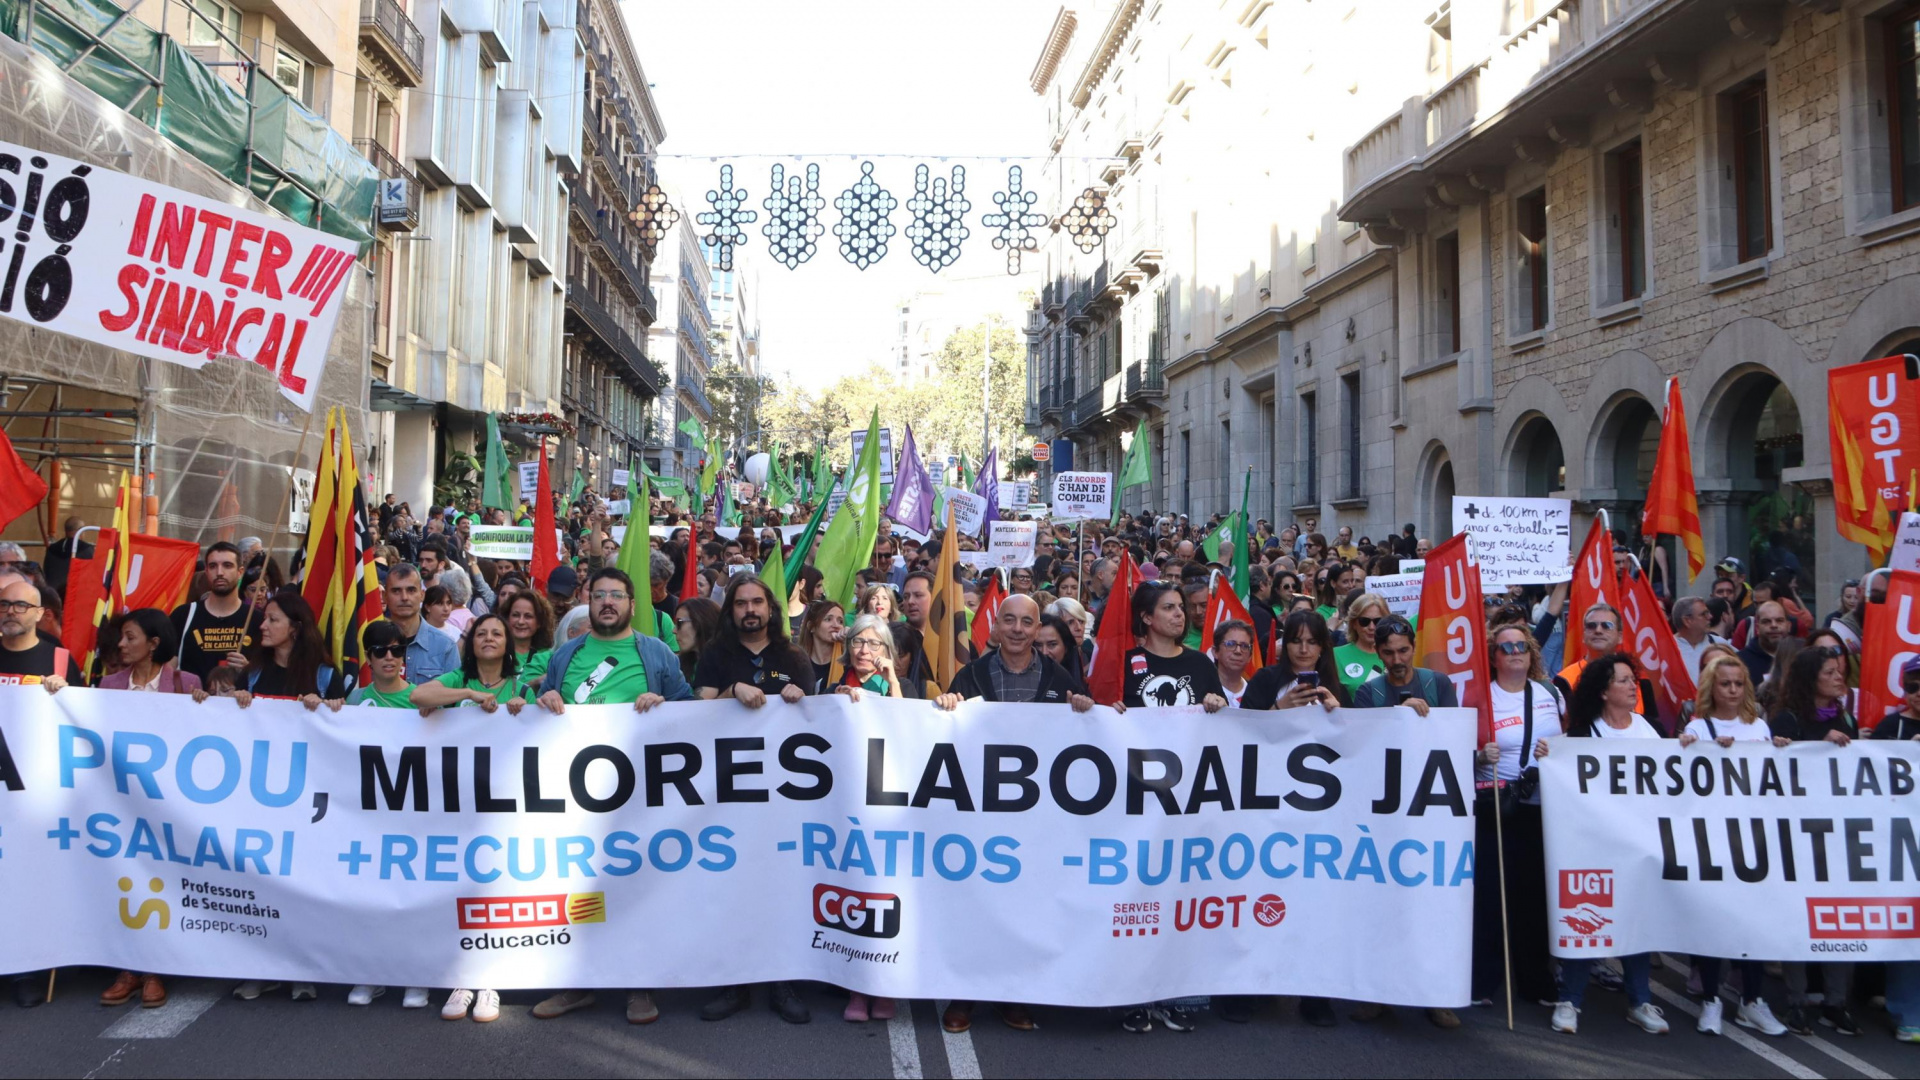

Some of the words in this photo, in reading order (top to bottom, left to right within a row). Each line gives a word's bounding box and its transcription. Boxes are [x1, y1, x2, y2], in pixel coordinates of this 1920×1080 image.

[127, 193, 293, 300] INTER
[1058, 483, 1088, 492] S'HAN
[1091, 484, 1105, 493] DE
[1057, 493, 1105, 504] COMPLIR!
[1545, 508, 1564, 522] per
[1463, 524, 1489, 532] anar
[1493, 525, 1502, 533] a
[1503, 520, 1553, 536] treballar
[474, 532, 515, 542] DIGNIFIQUEM
[516, 534, 524, 542] LA
[1505, 552, 1541, 563] salut
[1480, 566, 1504, 581] enys
[1507, 566, 1531, 578] poder
[1371, 580, 1404, 588] MATEIXA
[1138, 673, 1155, 689] LUCHA
[1177, 678, 1187, 689] CGT
[1502, 718, 1515, 726] UGT
[58, 724, 329, 824] PROU,
[359, 733, 834, 812] MILLORES
[866, 737, 1342, 816] LABORALS
[1371, 748, 1478, 817] JA
[1577, 755, 1807, 797] PERSONAL
[1828, 757, 1920, 796] LAB
[47, 812, 295, 877] +SALARI
[337, 825, 737, 883] +RECURSOS
[777, 816, 1022, 884] -RÀTIOS
[181, 878, 256, 900] Professors
[1567, 873, 1613, 896] UGT
[181, 896, 199, 908] de
[201, 897, 280, 919] Secundària
[464, 900, 559, 924] CCOO
[818, 889, 894, 934] CGT
[1113, 901, 1160, 913] SERVEIS
[1174, 894, 1247, 932] UGT
[1113, 912, 1160, 926] PÚBLICS
[1814, 905, 1914, 930] CCOO
[459, 930, 572, 951] educació
[811, 931, 900, 964] Ensenyament
[1810, 940, 1868, 952] educació
